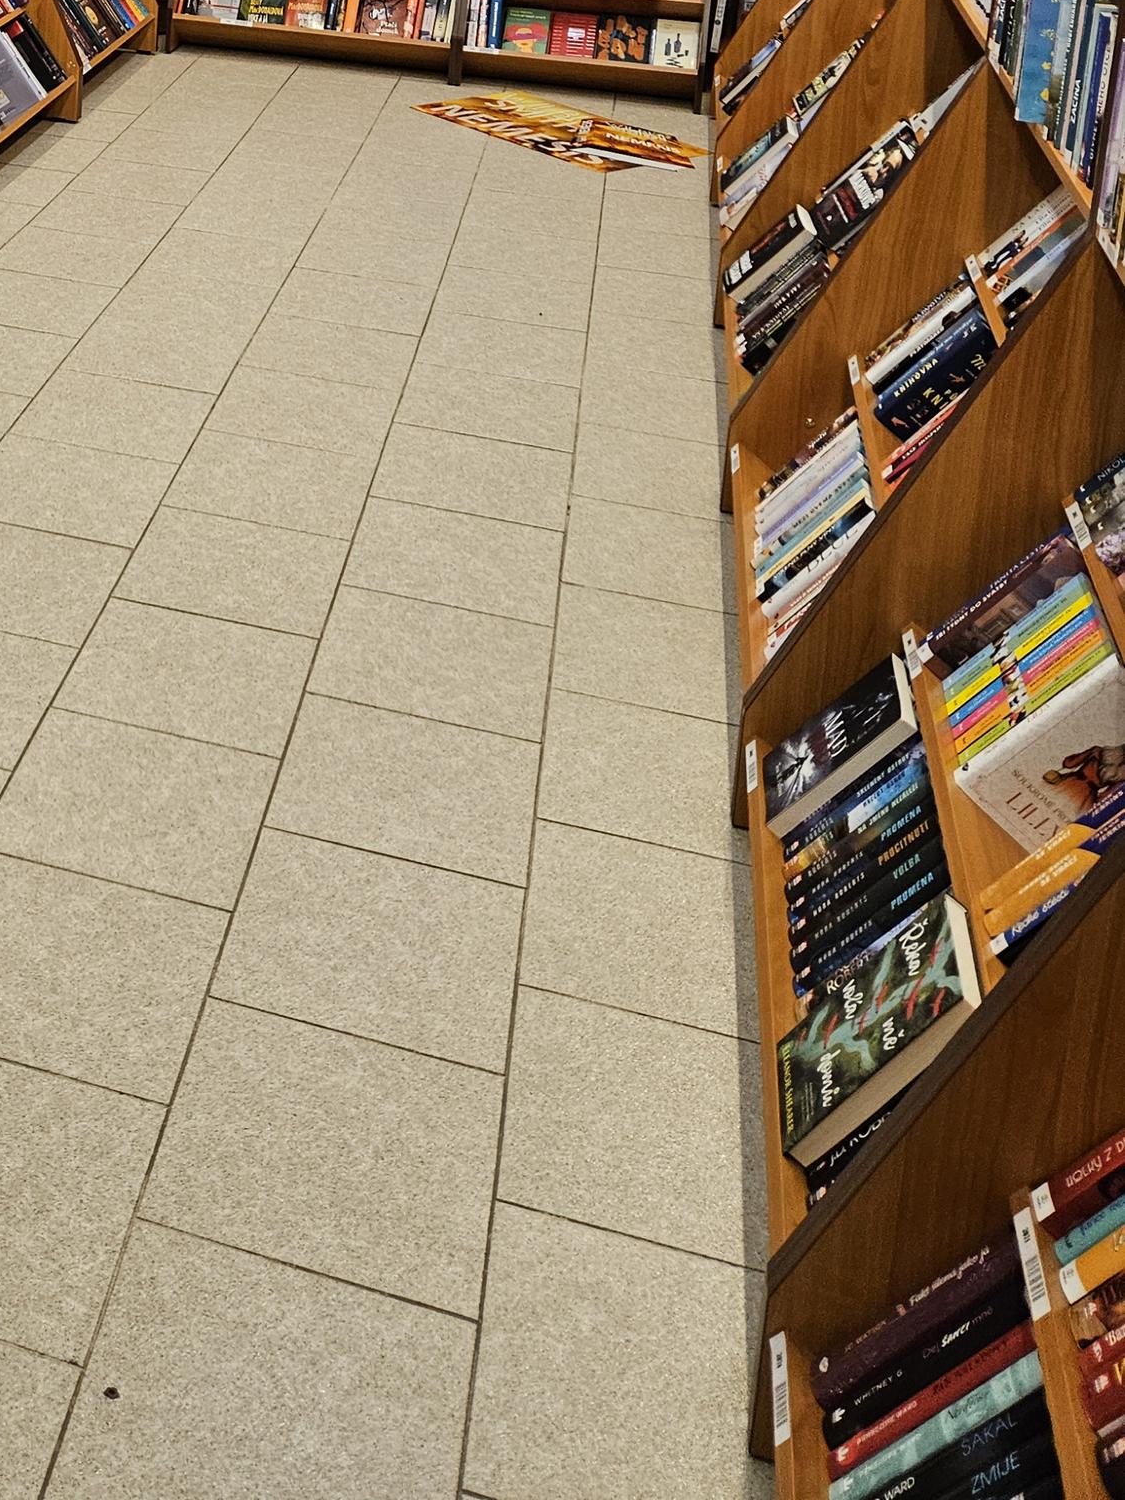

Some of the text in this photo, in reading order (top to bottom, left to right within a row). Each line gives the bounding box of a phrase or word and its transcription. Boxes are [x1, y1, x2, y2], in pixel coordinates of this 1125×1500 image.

[893, 357, 938, 398] KNIHOVNA
[880, 805, 922, 842] PROMĚNA
[877, 821, 930, 866] PROCITNUTÍ
[892, 854, 921, 880] VOLBA
[890, 872, 934, 910] PROMĚNA
[784, 1090, 795, 1134] SHEARER
[853, 1375, 892, 1406] WHITNEY
[970, 1450, 1020, 1495] ZMIJE
